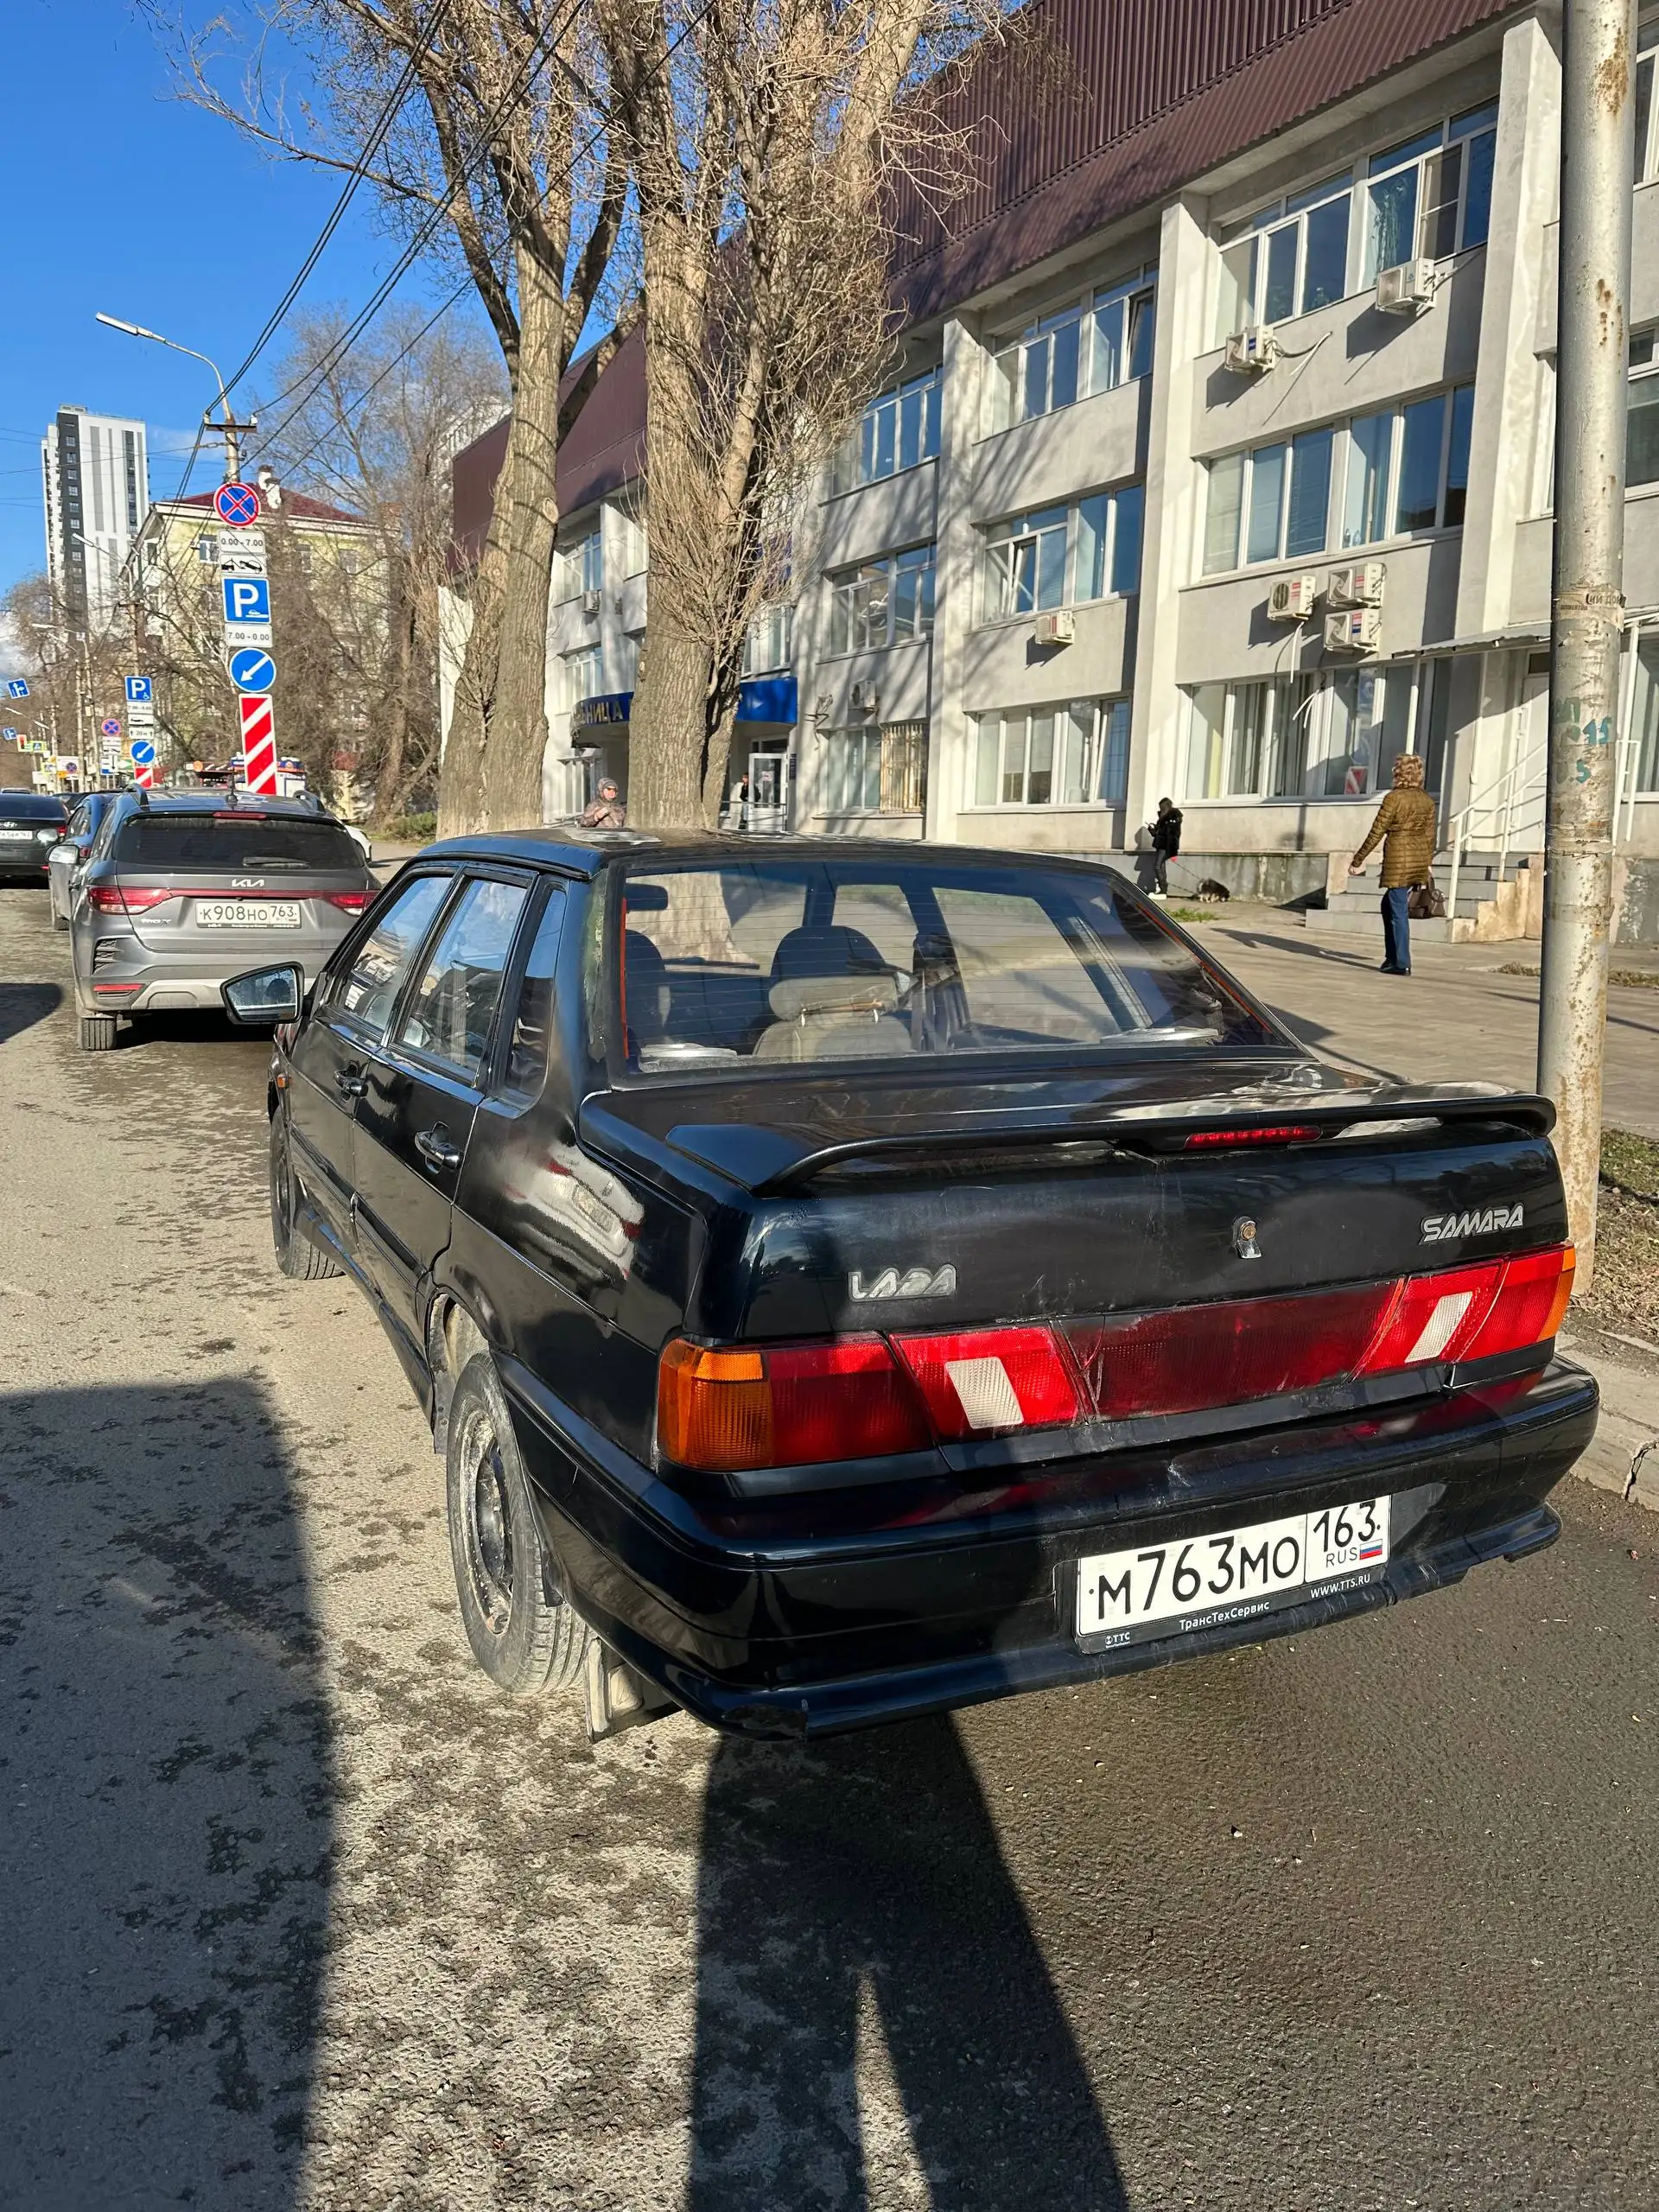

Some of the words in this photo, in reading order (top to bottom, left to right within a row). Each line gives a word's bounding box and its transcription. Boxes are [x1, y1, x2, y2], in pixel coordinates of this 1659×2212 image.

[221, 537, 238, 546] 0.00
[246, 538, 264, 547] 7.00
[233, 583, 259, 618] P
[227, 632, 245, 640] 7.00
[131, 679, 146, 698] P
[232, 879, 265, 887] KIA
[203, 906, 267, 920] К908НО
[270, 906, 294, 917] 763
[1422, 1204, 1524, 1243] SAMARA
[849, 1264, 957, 1301] LADA
[1098, 1536, 1300, 1619] М763МО
[1313, 1500, 1377, 1552] 163
[1325, 1548, 1358, 1568] RUS
[1310, 1573, 1371, 1599] WWW.TTS.RU
[1179, 1601, 1270, 1630] ТрансТехСервис
